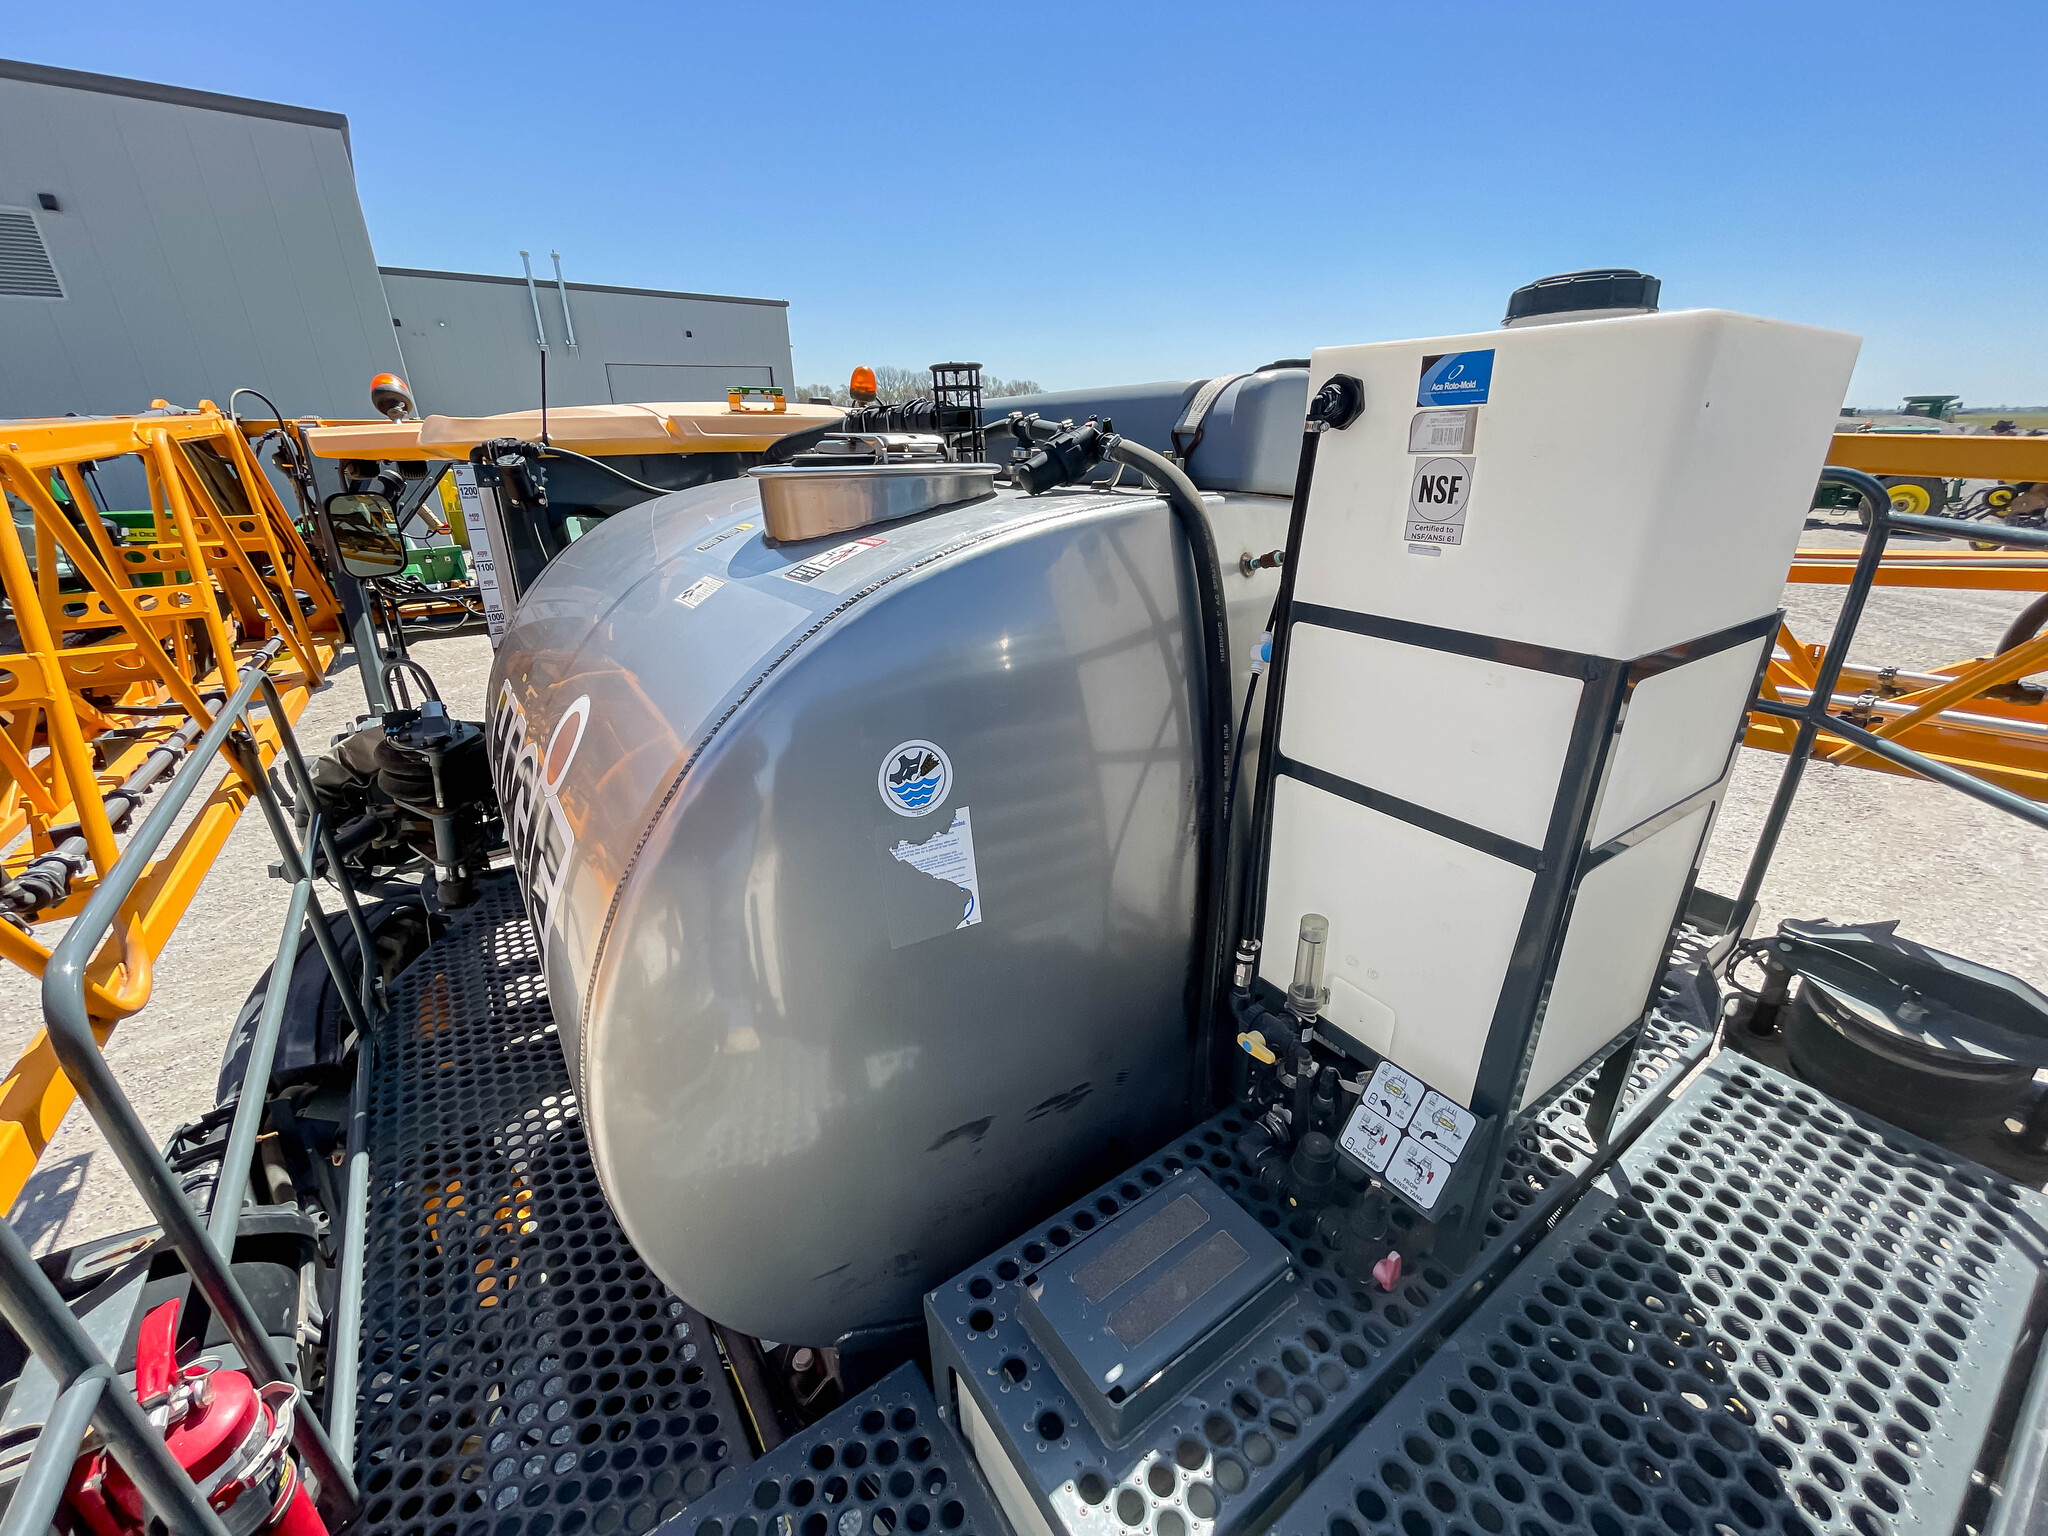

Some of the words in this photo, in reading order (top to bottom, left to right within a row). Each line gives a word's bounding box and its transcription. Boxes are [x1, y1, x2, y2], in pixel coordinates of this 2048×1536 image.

[1430, 383, 1443, 391] Ace
[1444, 380, 1477, 390] Roto-Mold
[459, 486, 478, 496] 1200
[1418, 474, 1463, 504] NSF
[1414, 524, 1445, 533] Certified
[1411, 533, 1446, 542] NSF/ANSI
[1446, 535, 1455, 543] 61
[476, 563, 494, 572] 1100
[487, 612, 505, 621] 1000
[1361, 1147, 1376, 1160] FROM
[1352, 1148, 1366, 1160] CHEM
[1366, 1157, 1380, 1171] TANK
[1402, 1177, 1419, 1191] FROM
[1392, 1177, 1409, 1192] RINSE
[1408, 1188, 1424, 1203] TANK
